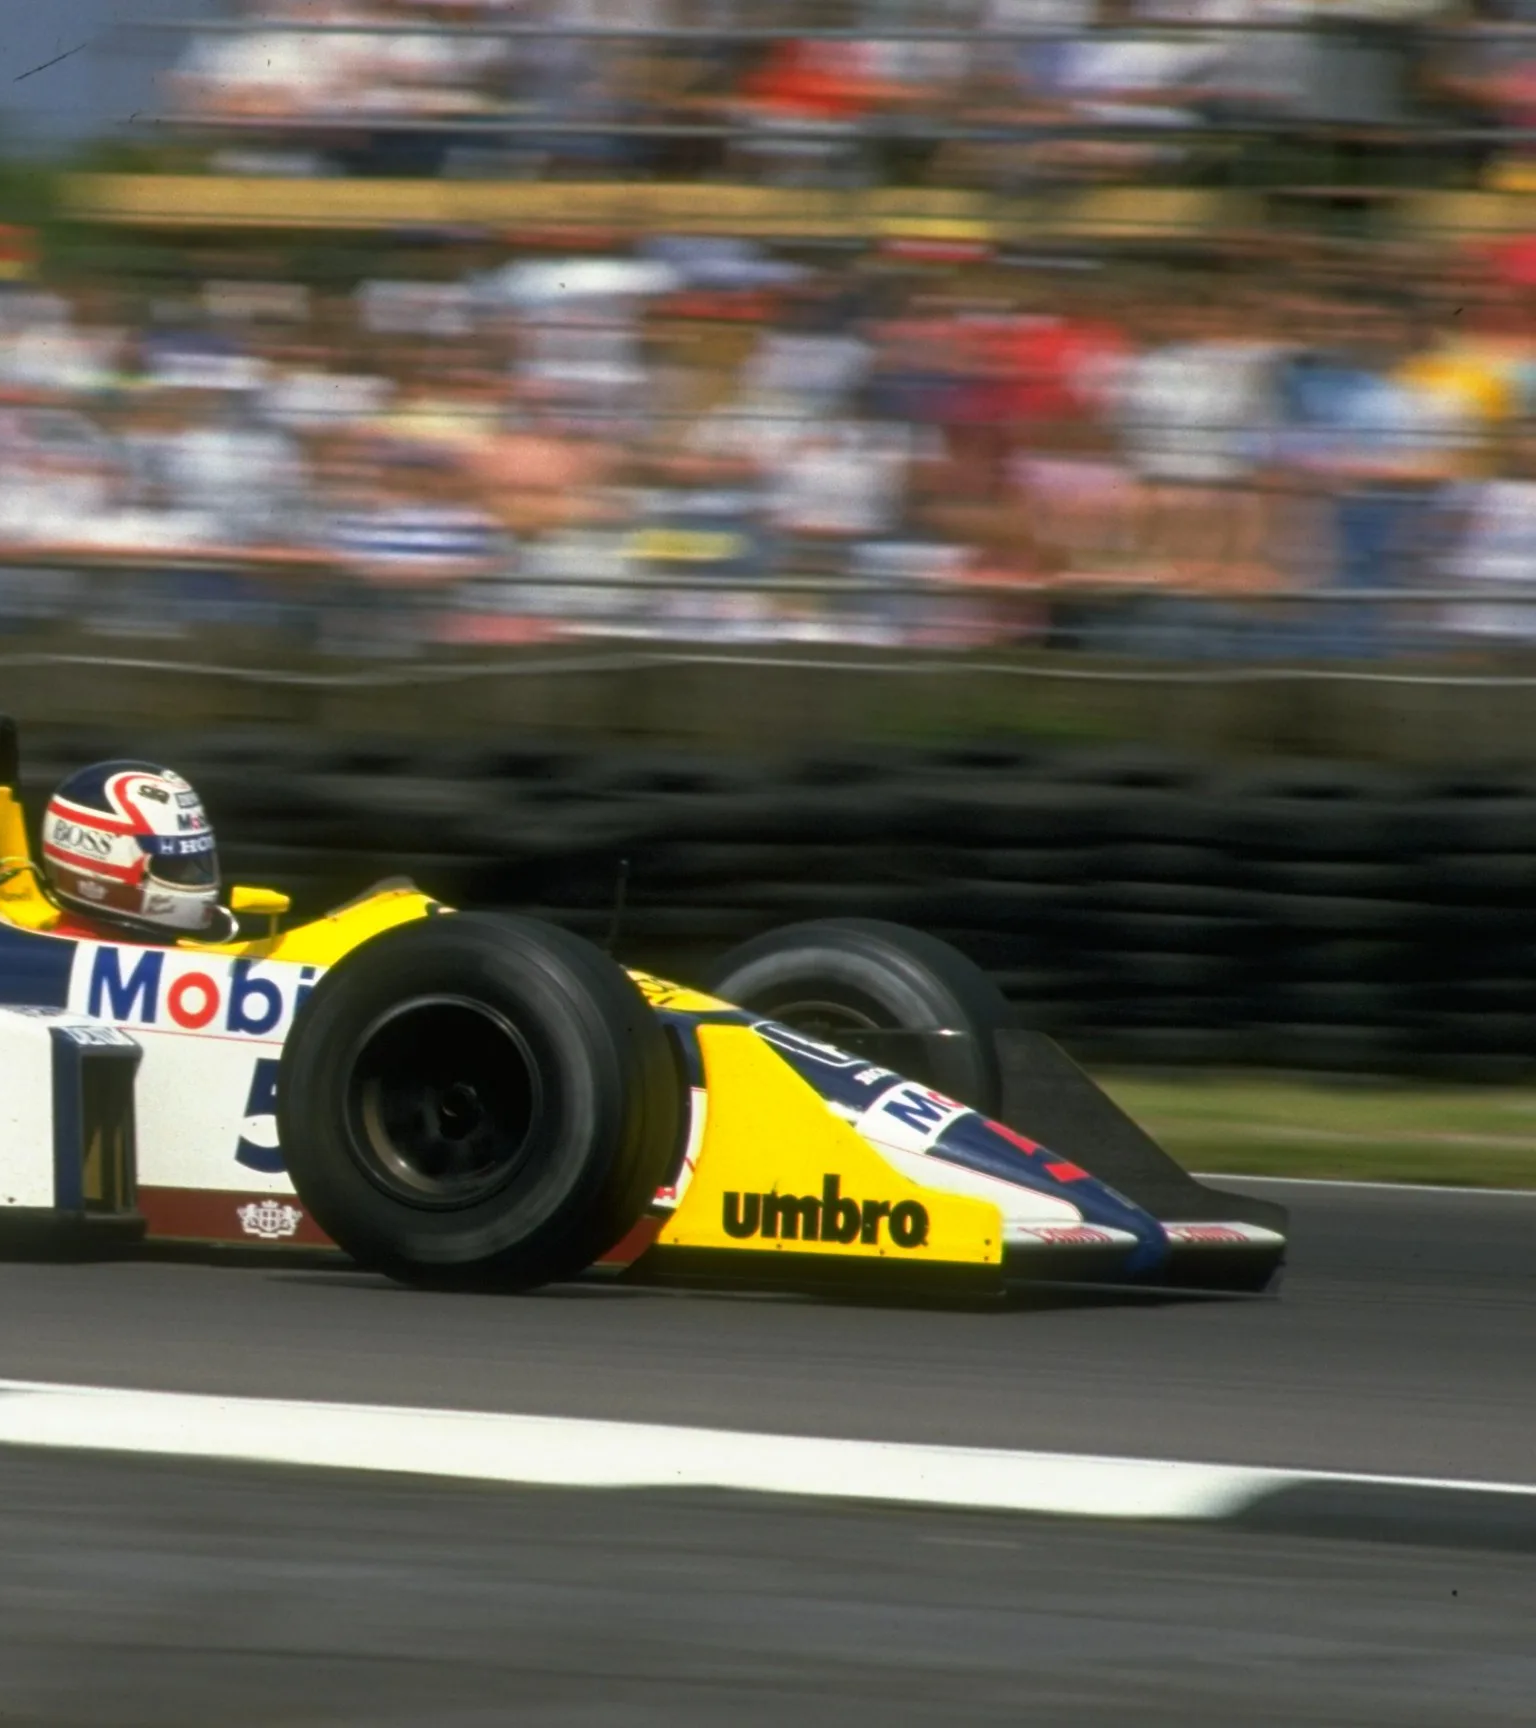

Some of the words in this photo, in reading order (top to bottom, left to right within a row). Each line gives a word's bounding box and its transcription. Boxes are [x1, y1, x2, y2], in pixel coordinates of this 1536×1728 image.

[52, 819, 113, 856] BOSS
[234, 1057, 289, 1174] 5
[722, 1173, 930, 1248] umbro
